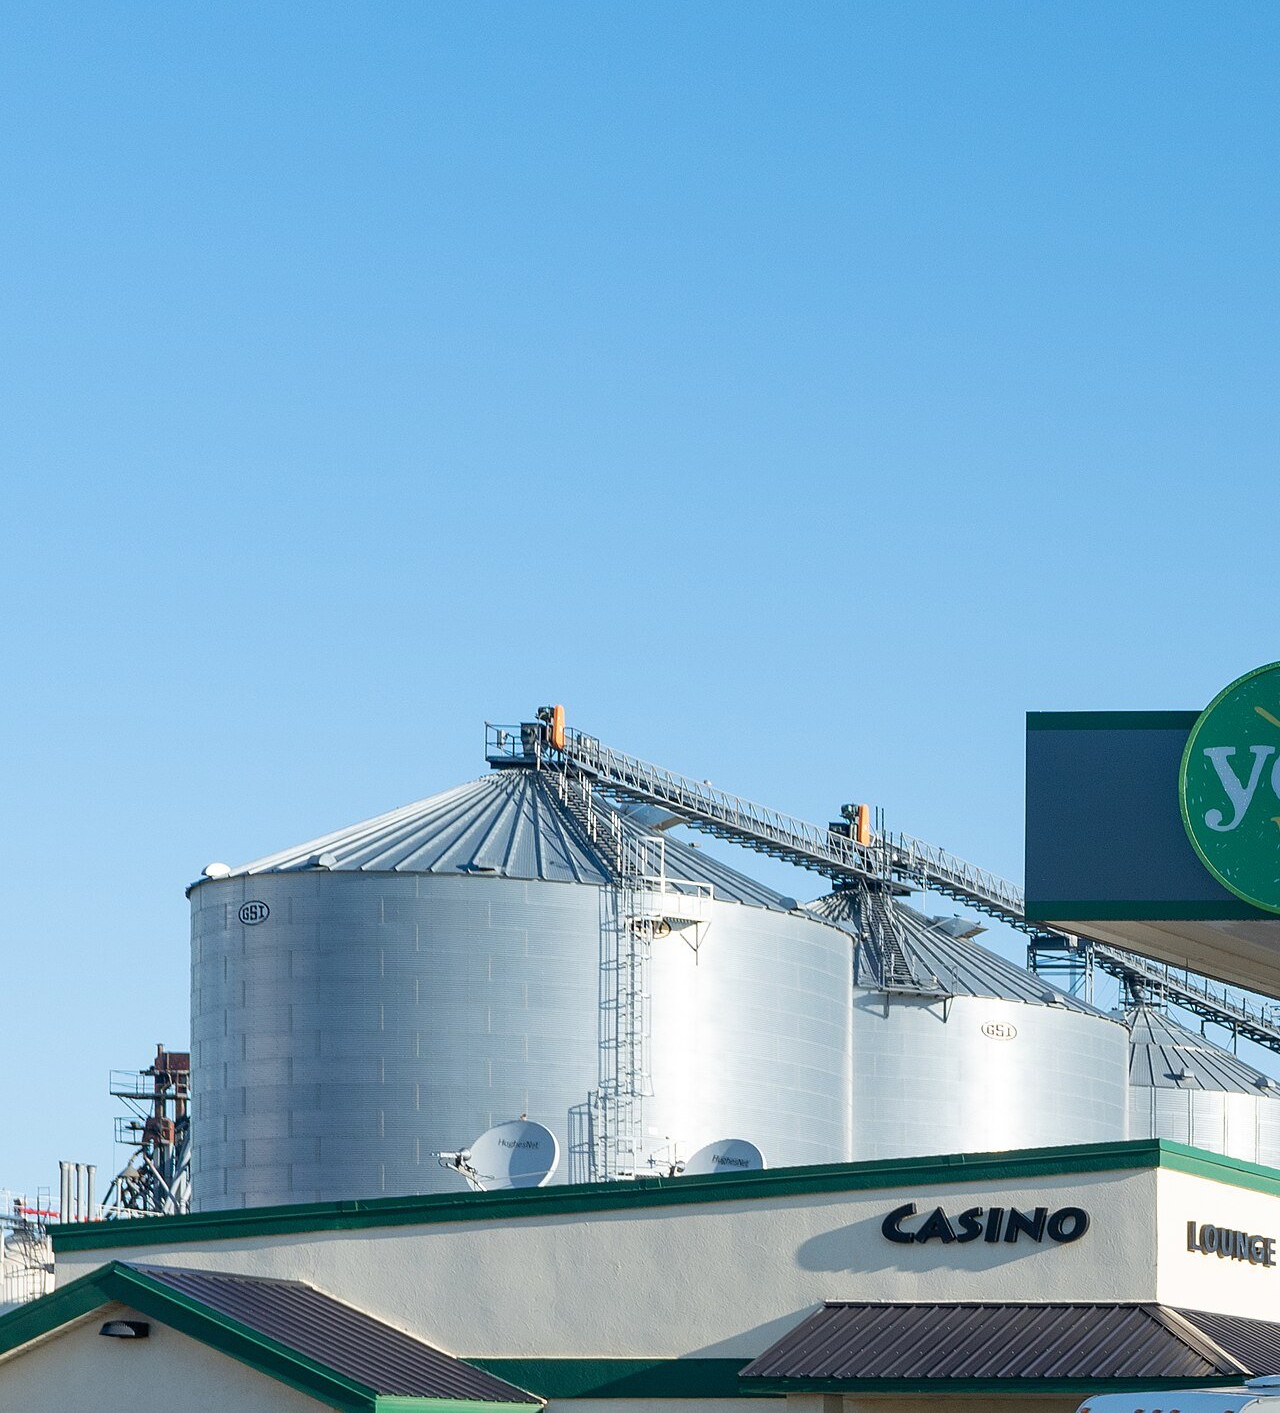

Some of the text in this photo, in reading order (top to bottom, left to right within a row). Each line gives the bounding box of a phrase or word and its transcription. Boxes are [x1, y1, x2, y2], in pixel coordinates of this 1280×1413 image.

[242, 904, 265, 921] GSI
[986, 1024, 1012, 1037] GSI
[497, 1137, 541, 1150] HughesNet
[711, 1154, 750, 1168] HughesNet
[881, 1202, 1091, 1244] CASINO
[1186, 1220, 1277, 1268] LOUNGE
